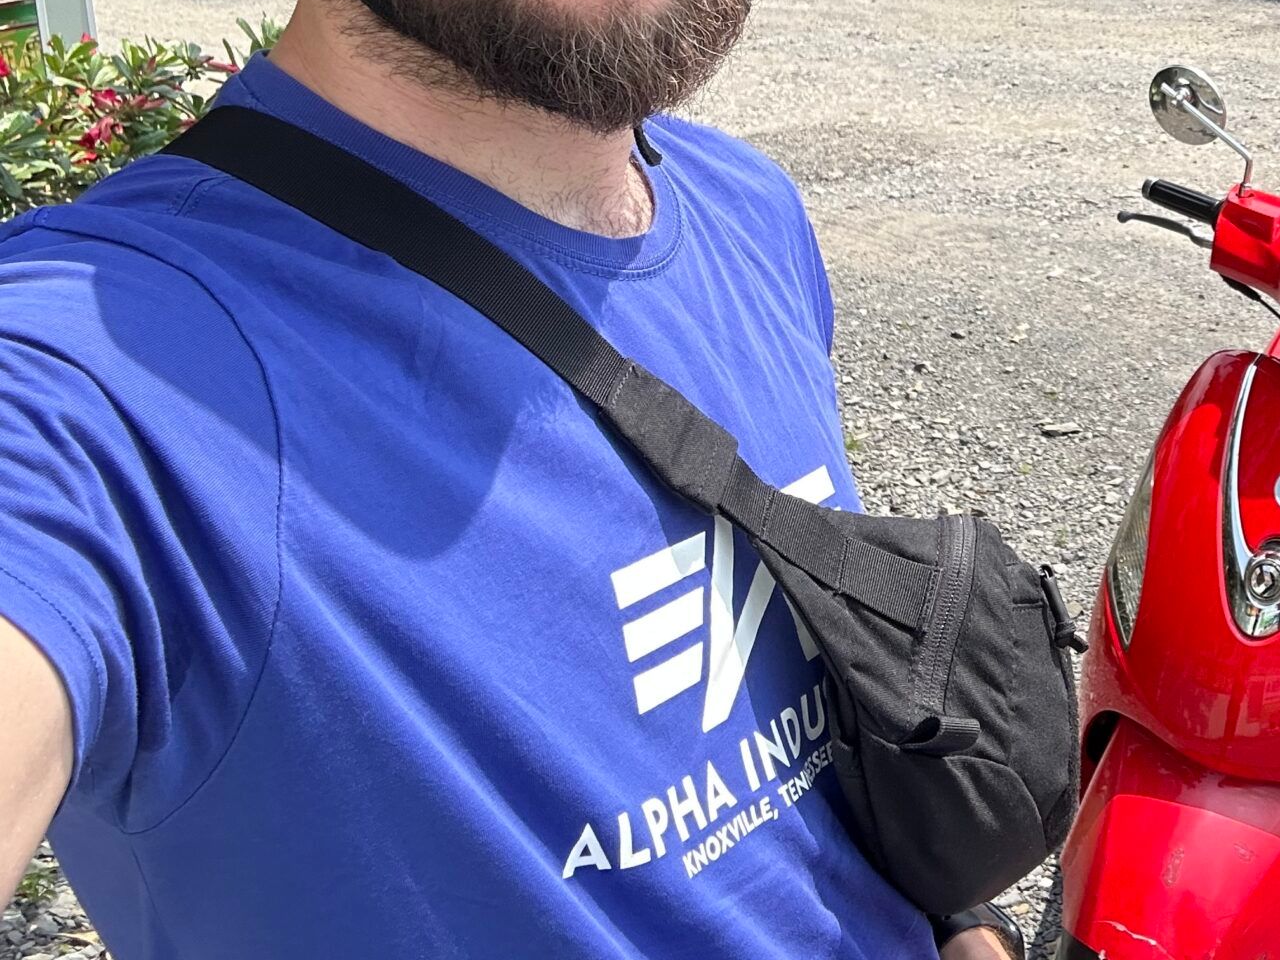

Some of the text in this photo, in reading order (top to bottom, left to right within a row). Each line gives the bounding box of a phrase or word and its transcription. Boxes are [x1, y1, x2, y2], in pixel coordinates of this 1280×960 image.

[562, 685, 827, 880] ALPHA INDU
[682, 796, 779, 879] KNOXVILLE,
